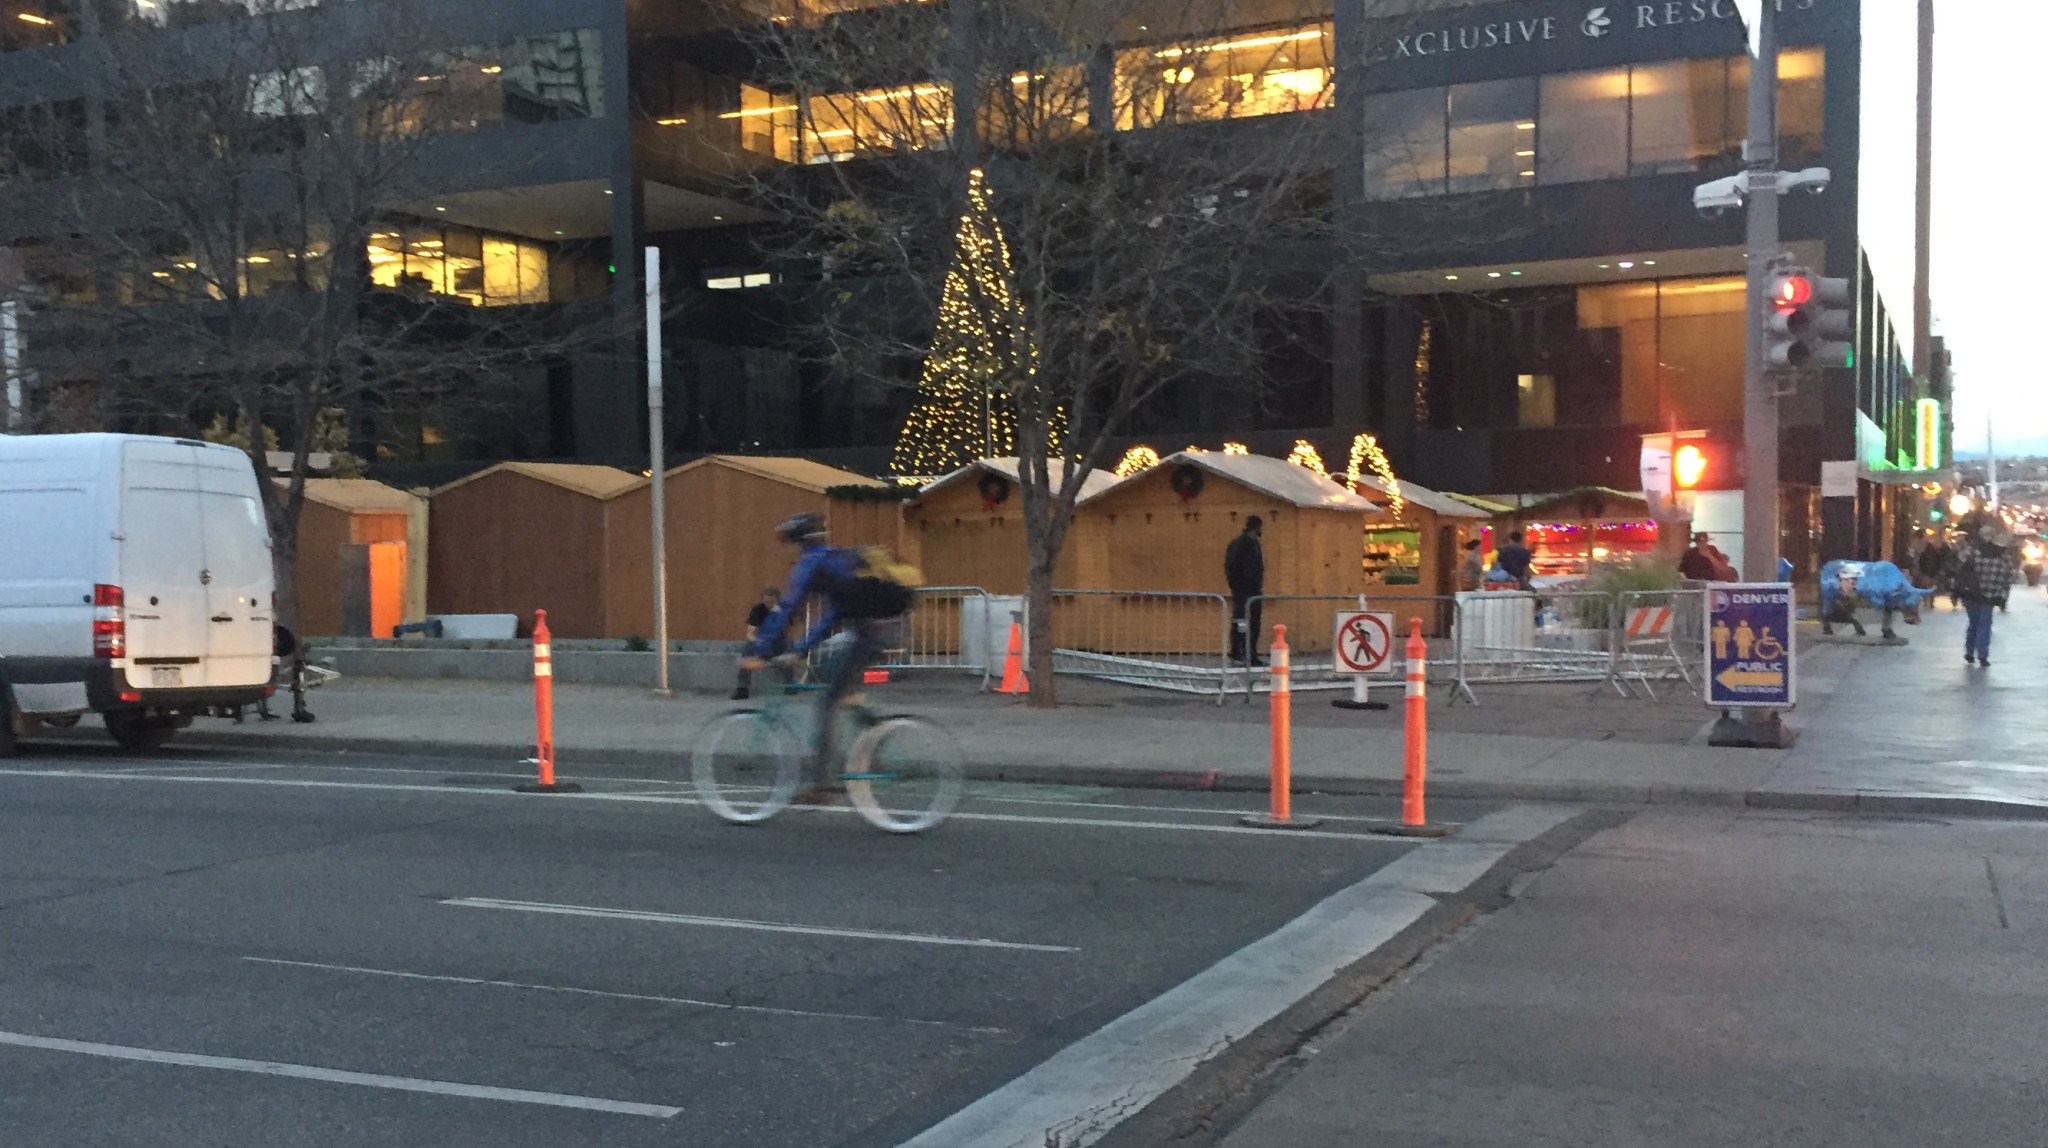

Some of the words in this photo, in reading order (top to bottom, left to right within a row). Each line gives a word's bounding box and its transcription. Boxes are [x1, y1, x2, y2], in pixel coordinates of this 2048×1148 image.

[1636, 0, 1813, 28] RESO
[1732, 593, 1788, 604] DENVER
[1736, 661, 1783, 672] PUBLIC
